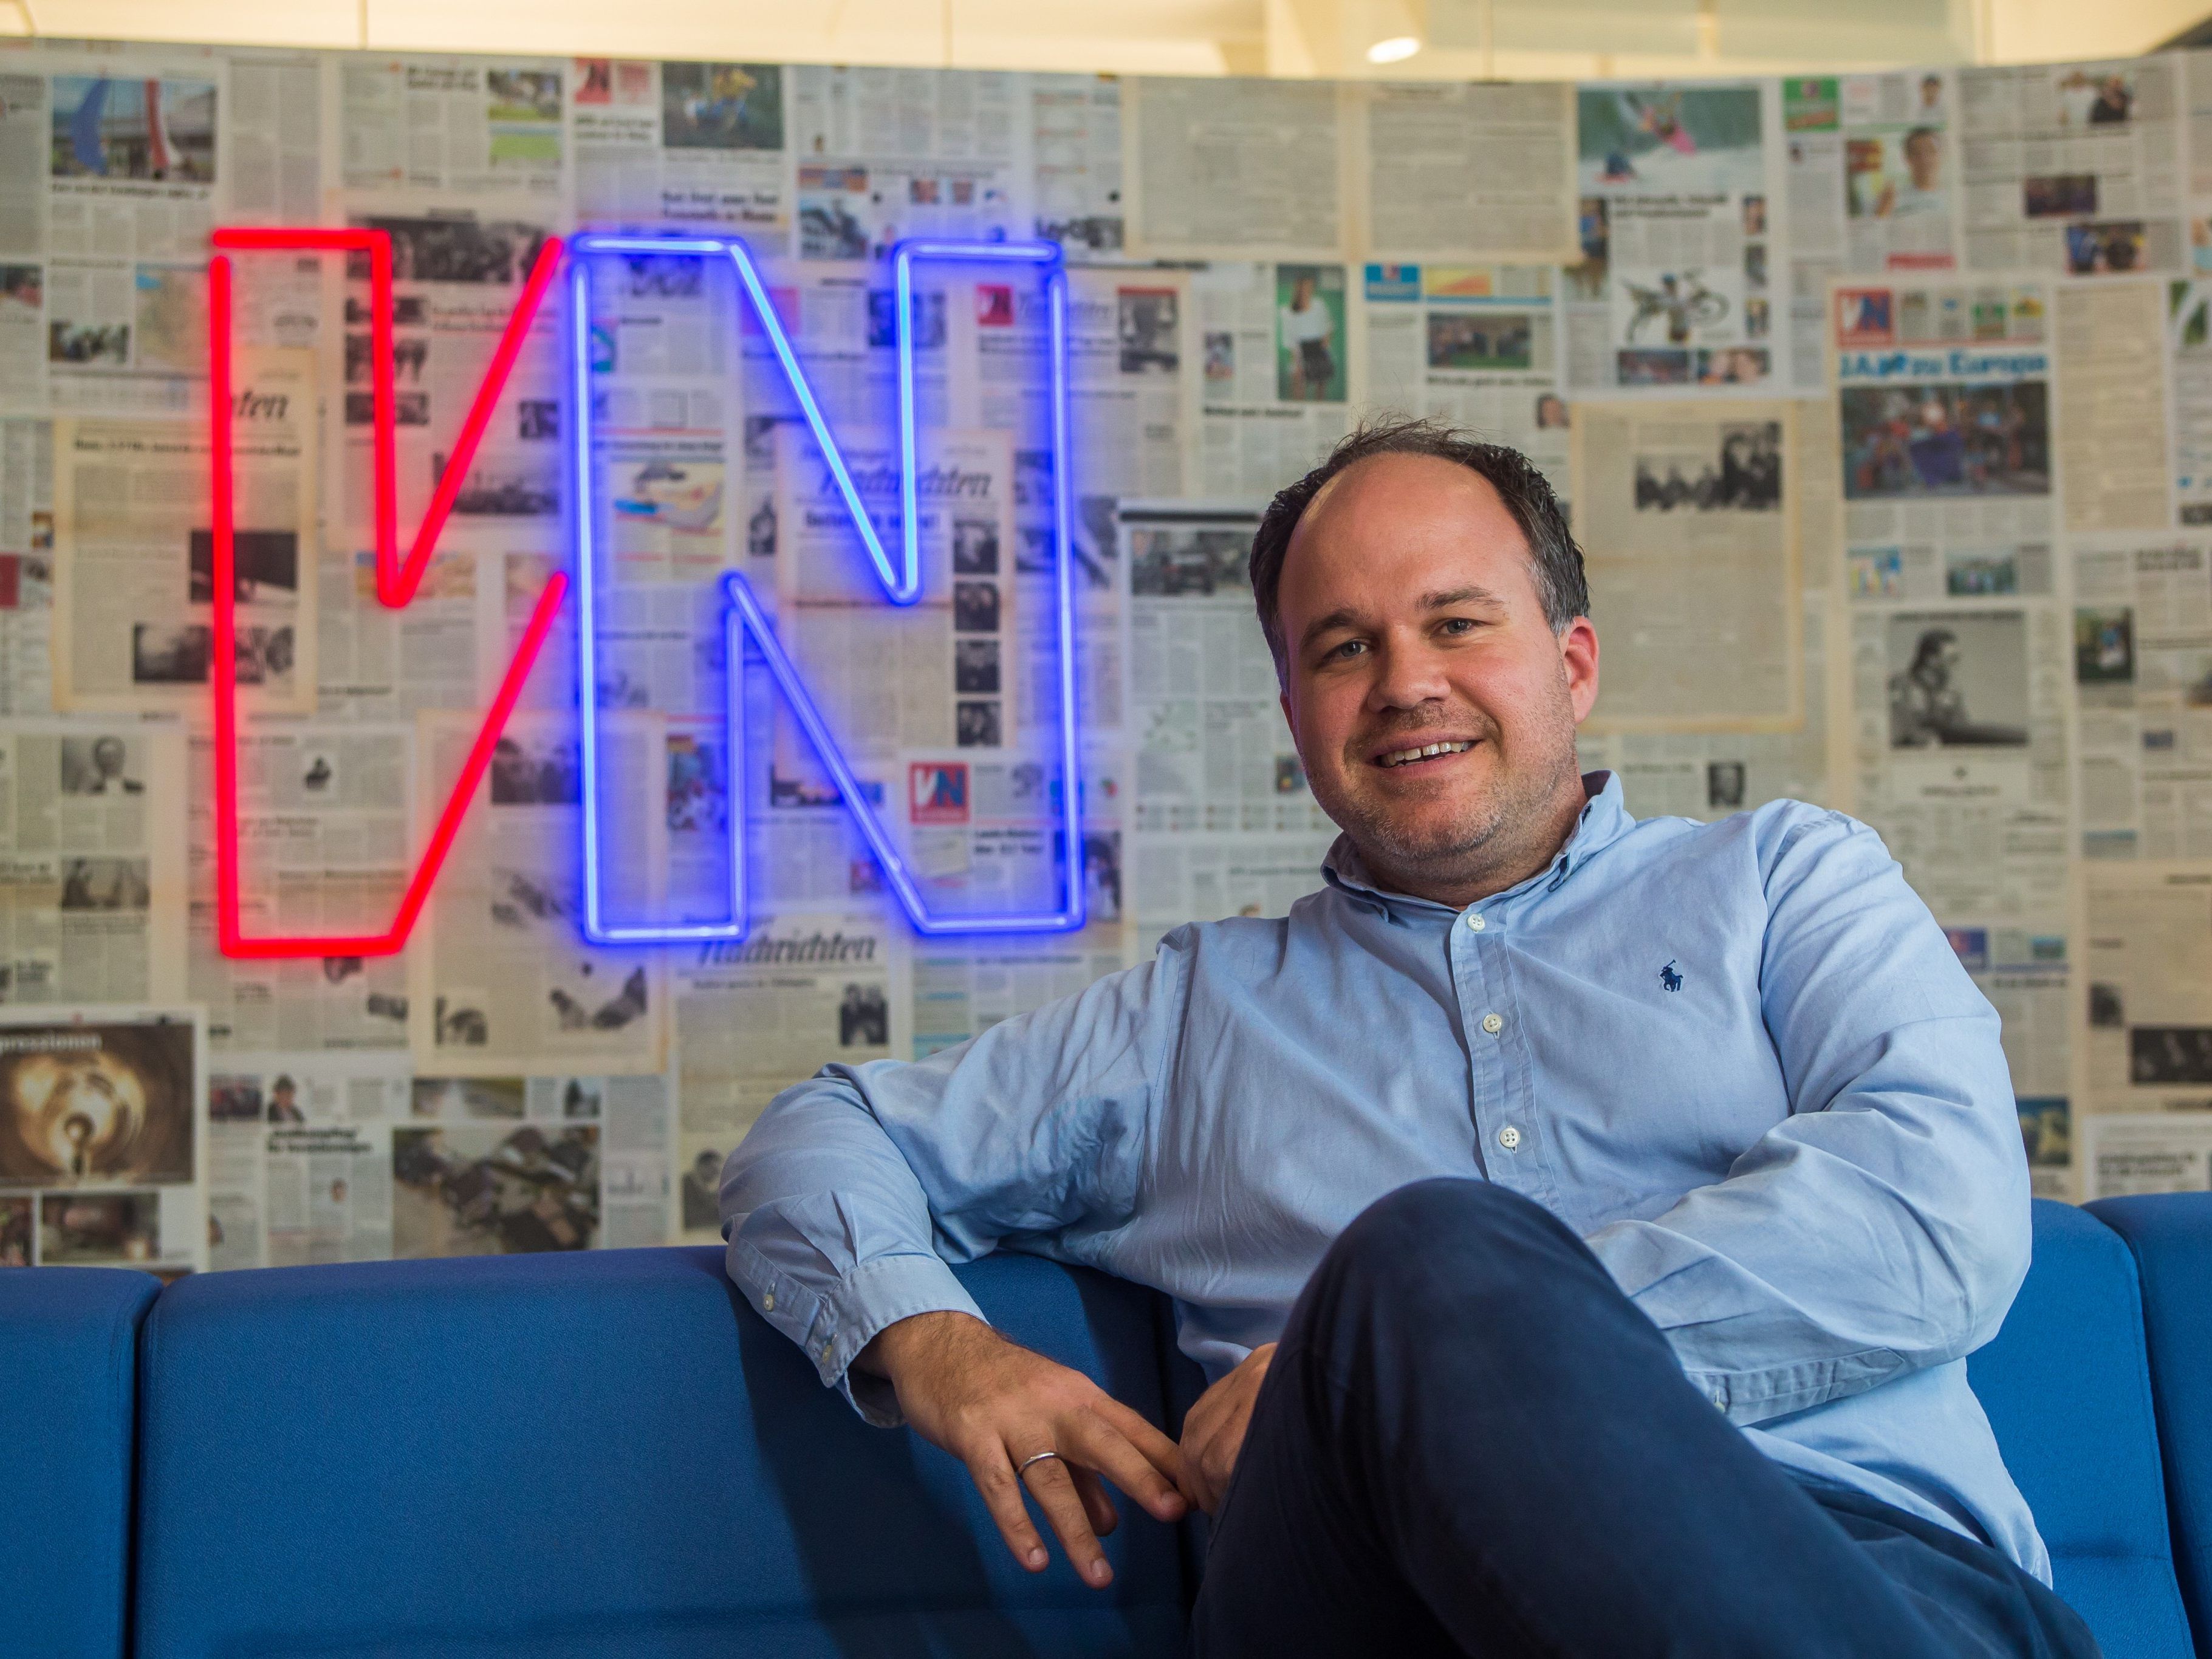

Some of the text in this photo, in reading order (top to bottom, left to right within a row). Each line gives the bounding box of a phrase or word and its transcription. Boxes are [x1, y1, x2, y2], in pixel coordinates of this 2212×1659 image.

[208, 227, 1085, 958] VN
[914, 768, 966, 807] VN
[697, 928, 877, 965] Nachrichten
